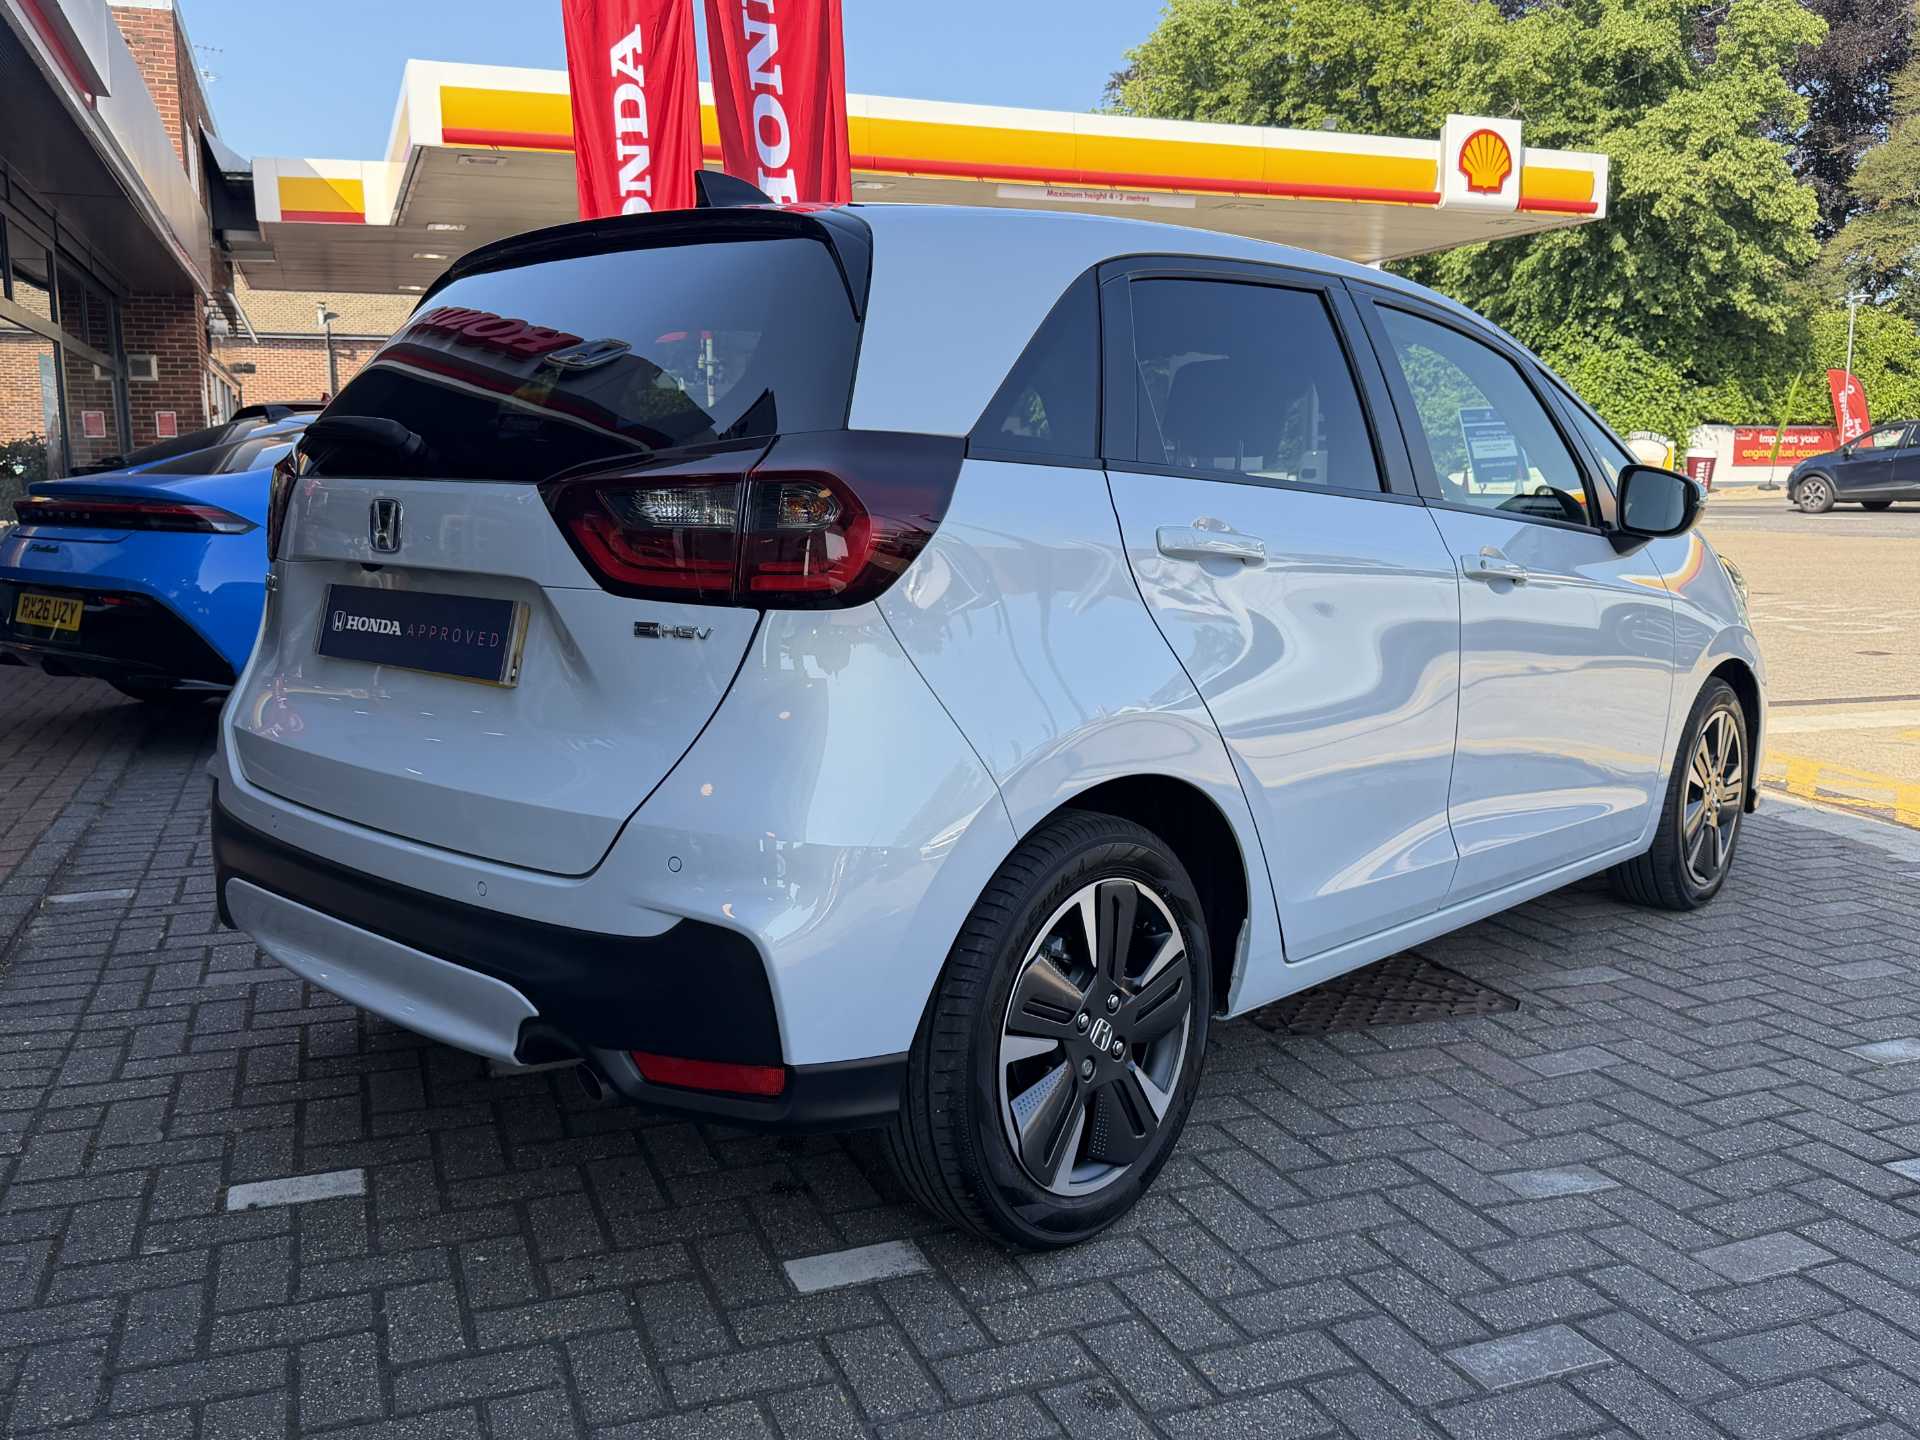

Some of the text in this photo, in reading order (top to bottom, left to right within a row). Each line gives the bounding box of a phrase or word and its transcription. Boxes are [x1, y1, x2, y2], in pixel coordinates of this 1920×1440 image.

[1084, 191, 1107, 201] height
[1126, 194, 1150, 203] metres
[1759, 433, 1799, 446] Impoves
[1800, 434, 1821, 446] your
[53, 601, 78, 625] UZY
[347, 615, 402, 636] HONDA
[406, 623, 500, 647] APPROVED
